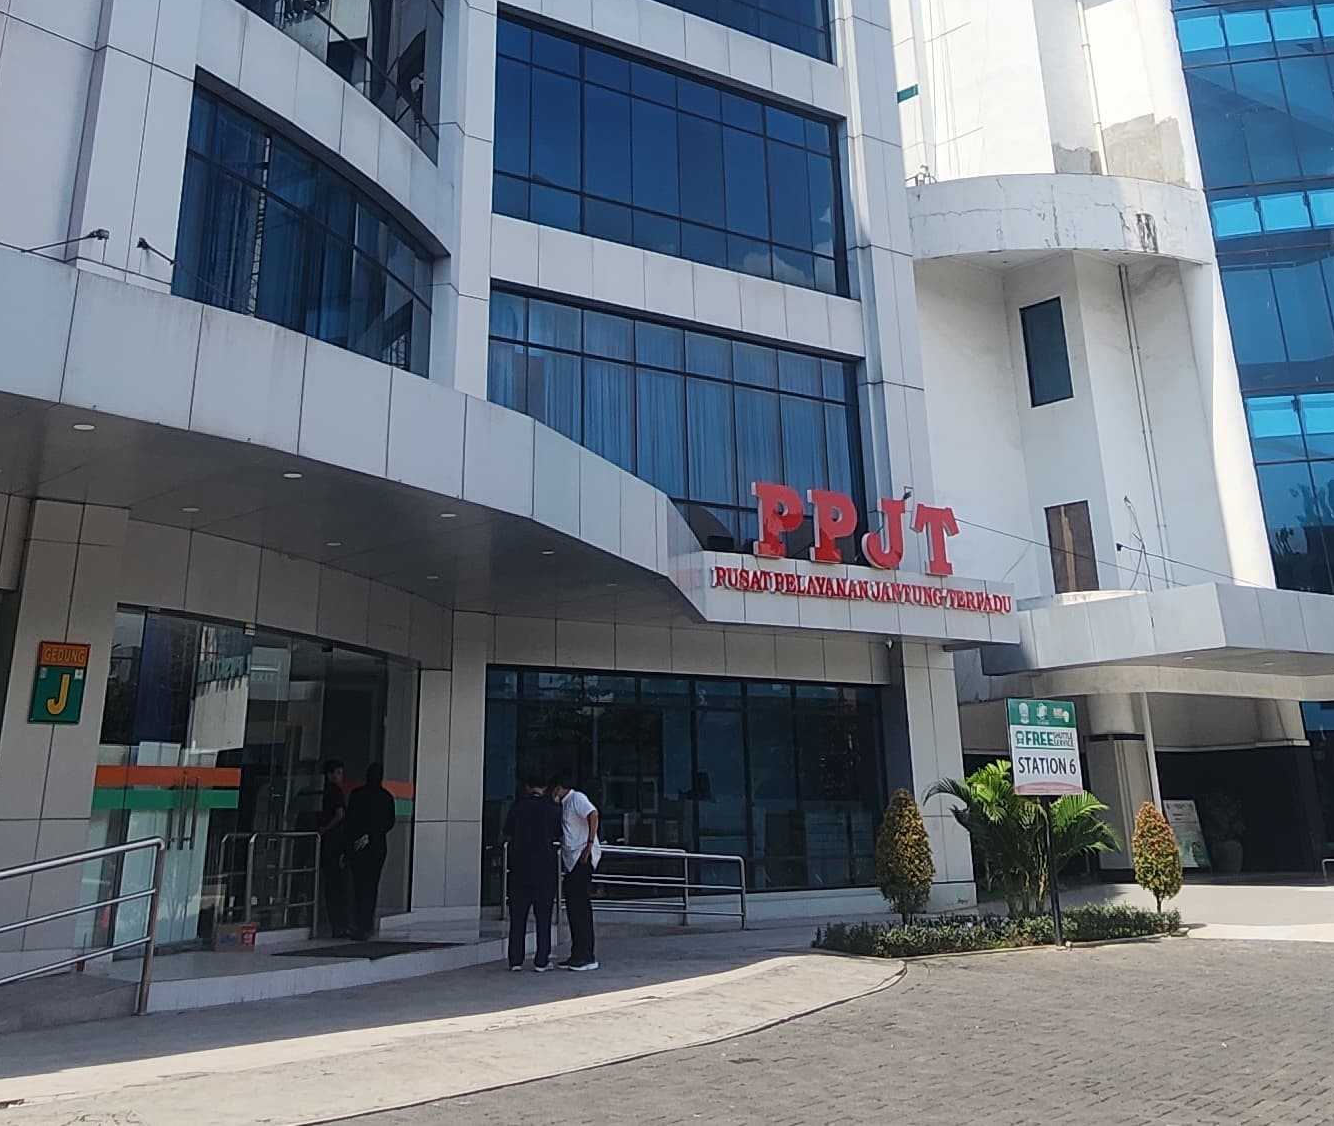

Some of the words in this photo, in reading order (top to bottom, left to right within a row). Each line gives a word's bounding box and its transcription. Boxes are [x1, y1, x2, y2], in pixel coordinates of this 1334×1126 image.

[751, 481, 961, 576] PPJT
[711, 566, 770, 592] PUSAT
[771, 572, 870, 601] PELAYANAN
[871, 581, 943, 609] JANTUNG
[944, 588, 1013, 615] TERPADU
[44, 648, 85, 663] GEDUNG
[47, 674, 71, 715] J
[1025, 731, 1053, 746] FREE
[1018, 757, 1067, 774] STATION
[1069, 758, 1077, 775] 6
